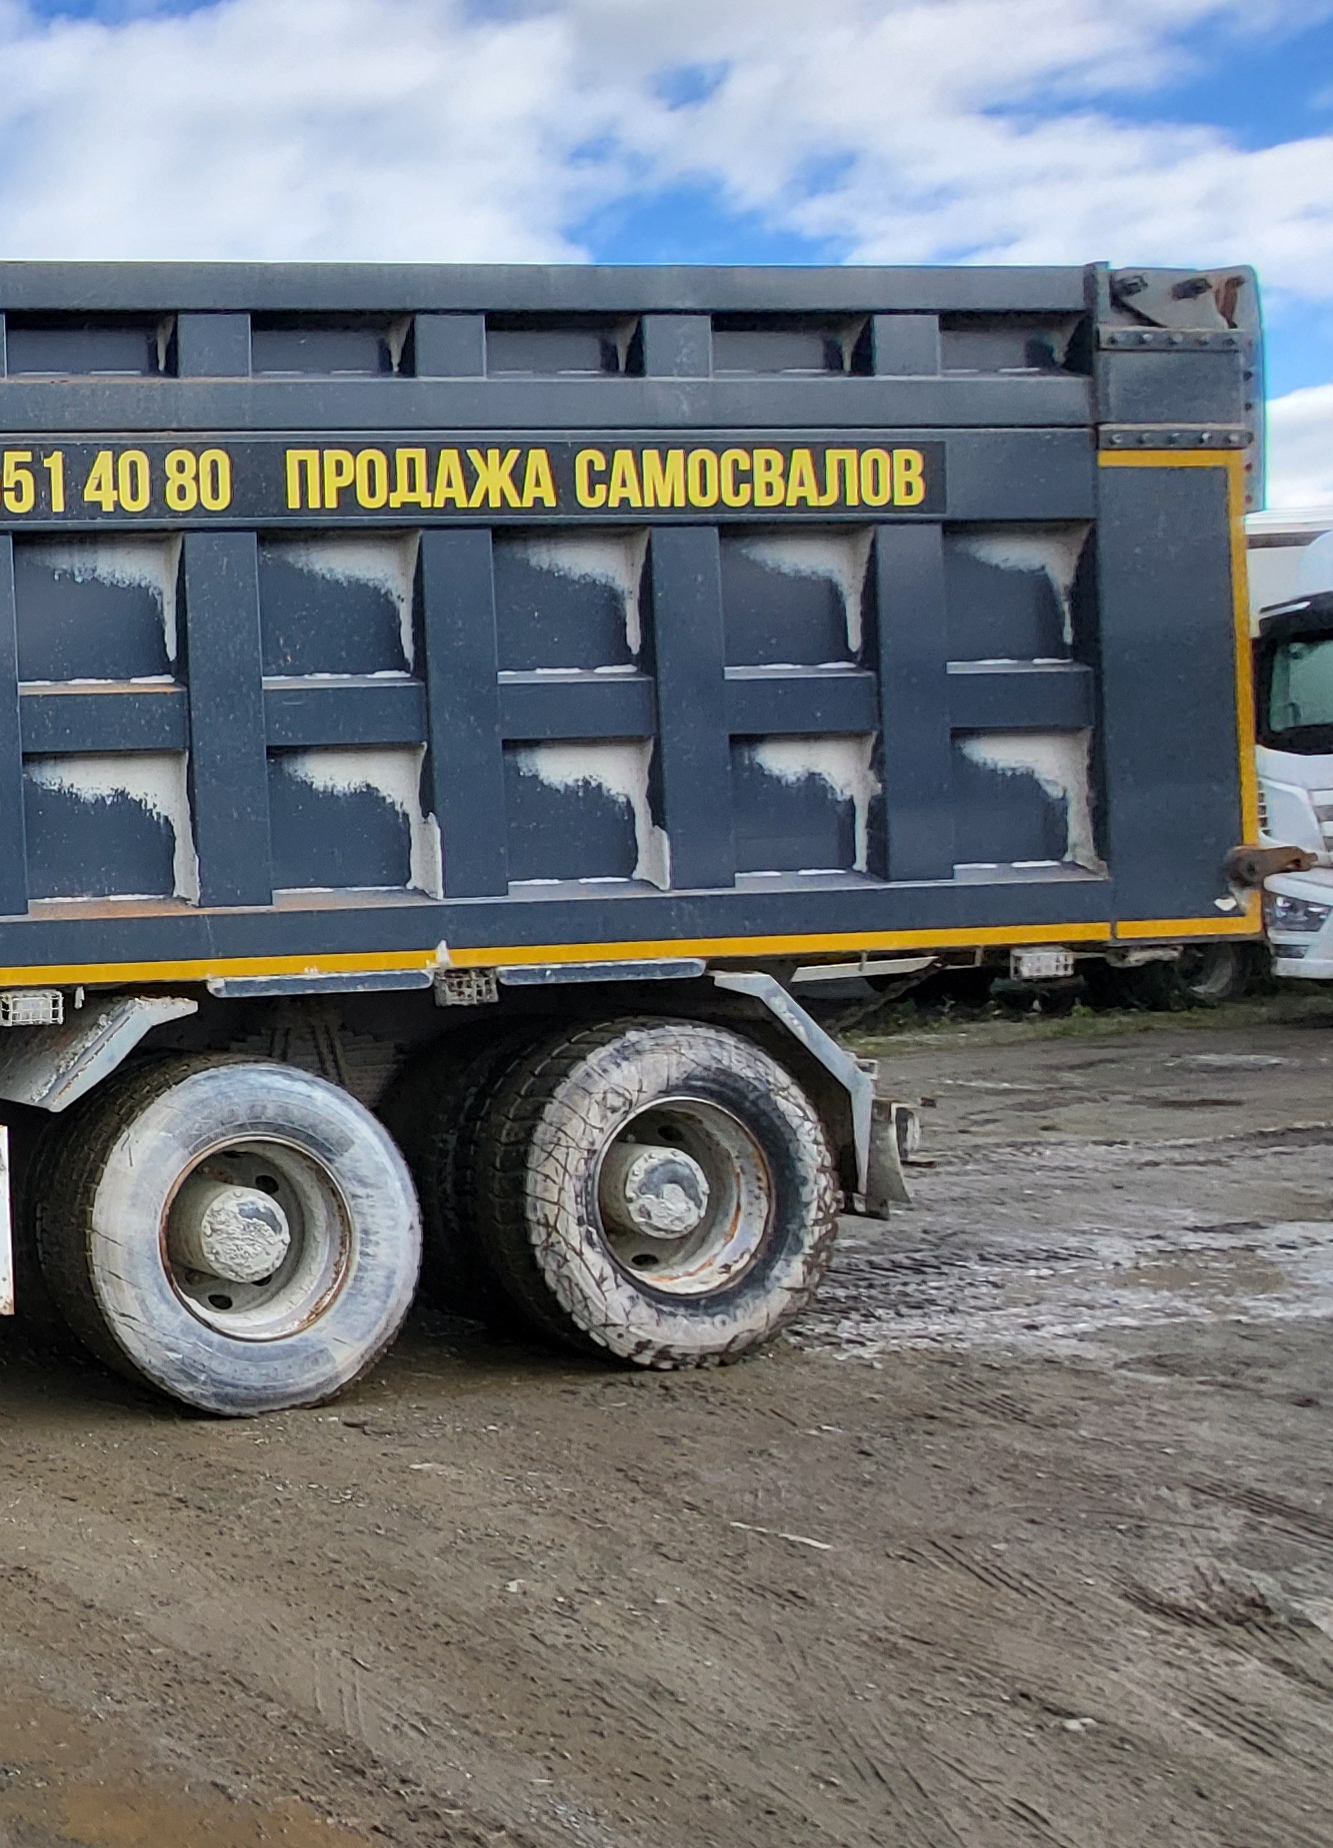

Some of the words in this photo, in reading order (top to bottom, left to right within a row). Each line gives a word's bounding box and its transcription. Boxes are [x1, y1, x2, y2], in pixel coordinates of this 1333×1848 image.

[82, 450, 149, 511] 40
[164, 449, 232, 510] 80
[285, 448, 558, 509] ПРОДАЖА
[575, 448, 925, 508] САМОСВАЛОВ
